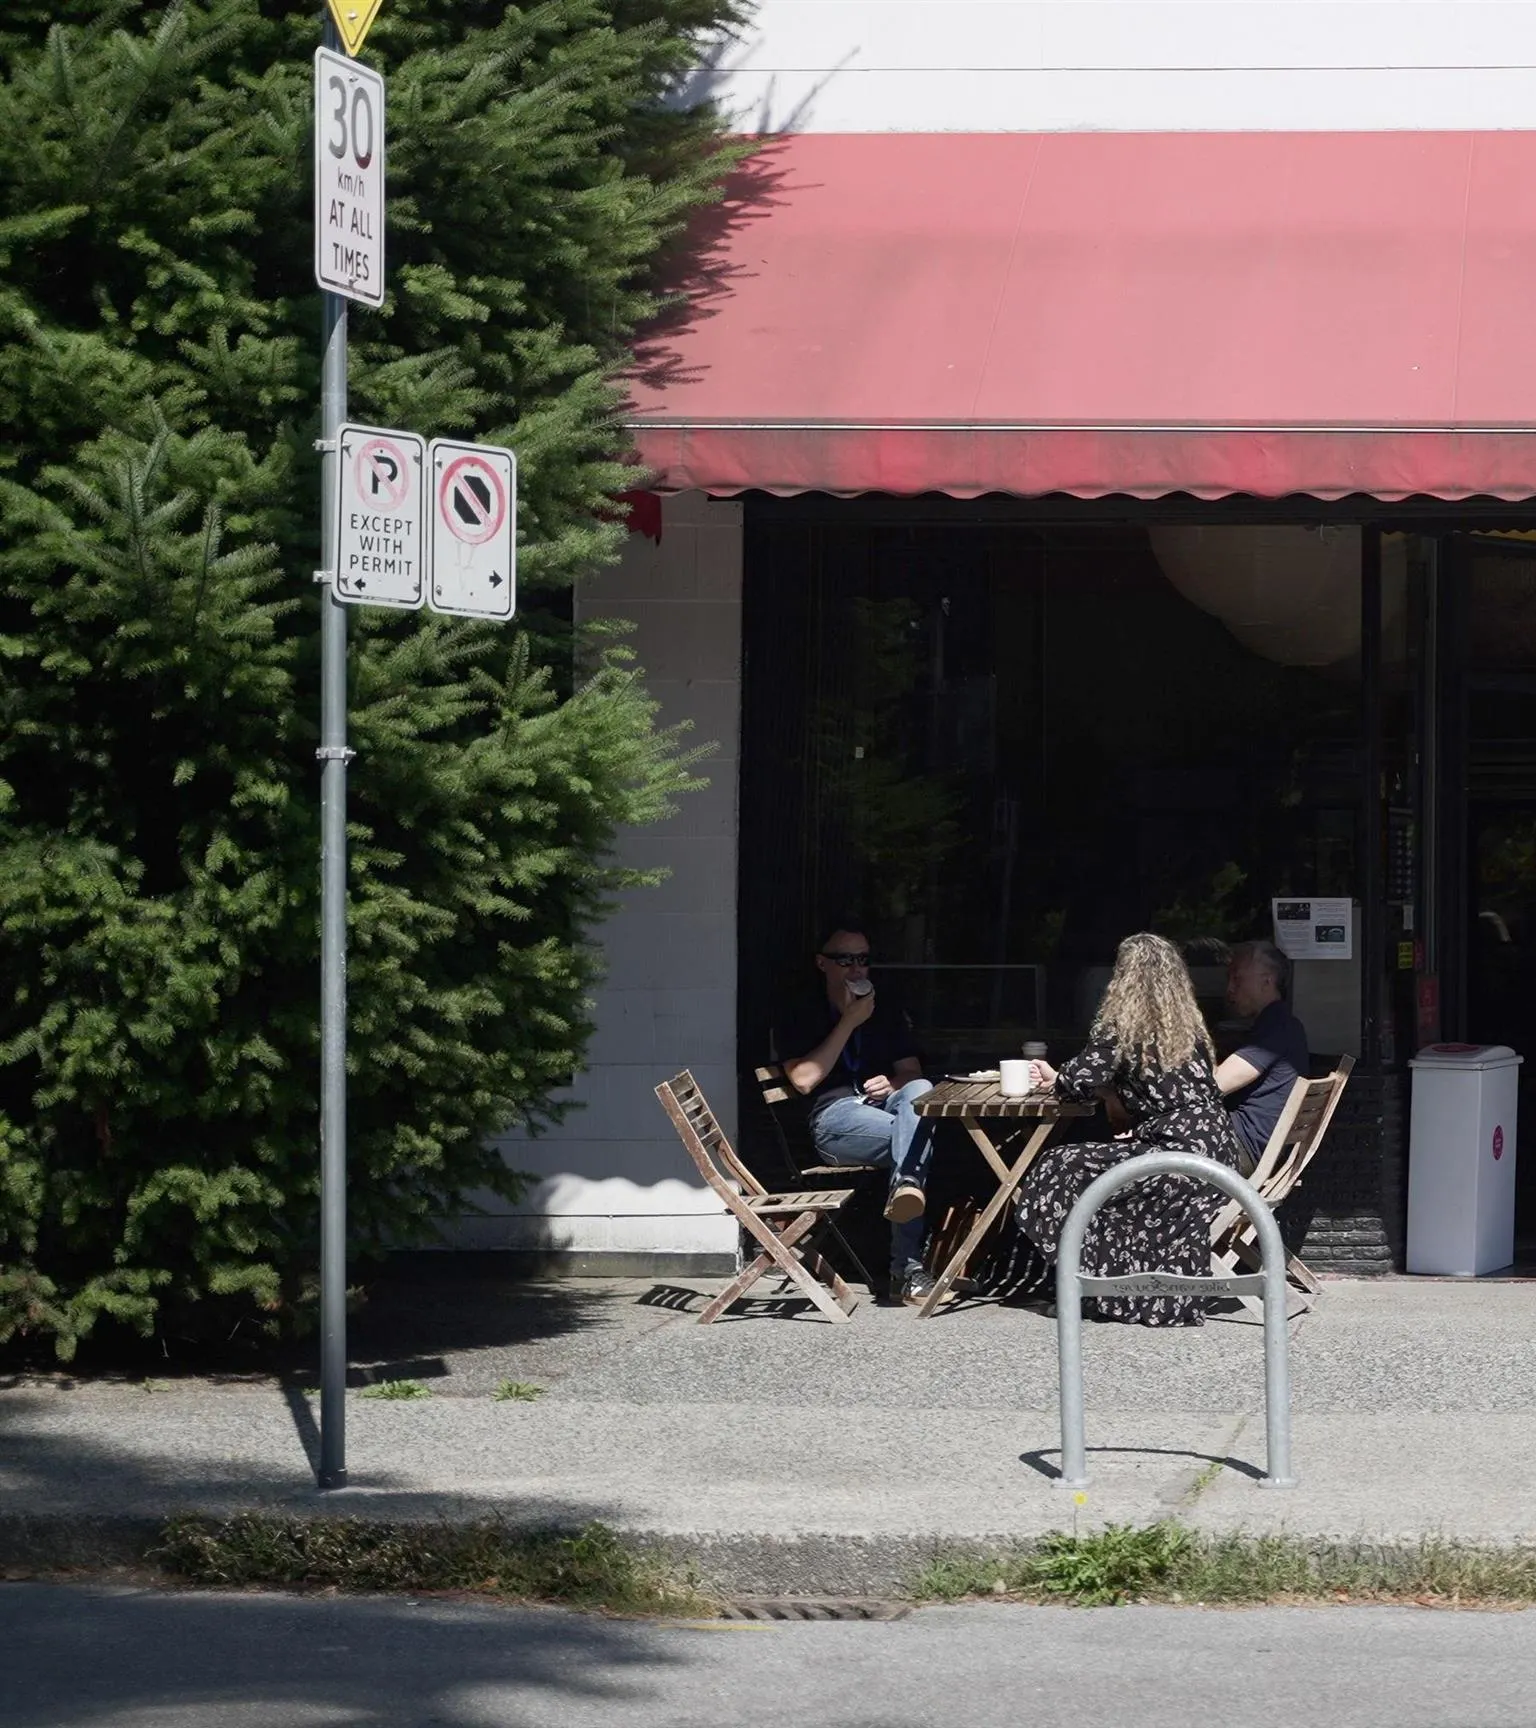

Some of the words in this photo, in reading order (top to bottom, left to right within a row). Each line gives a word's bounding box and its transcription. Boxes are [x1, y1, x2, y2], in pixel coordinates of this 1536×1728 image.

[328, 75, 373, 170] 30
[337, 166, 365, 197] km/h
[329, 199, 345, 228] AT
[350, 206, 373, 240] ALL
[332, 242, 370, 281] TIMES
[350, 513, 413, 536] EXCEPT
[359, 534, 403, 555] WITH
[350, 554, 413, 576] PERMIT
